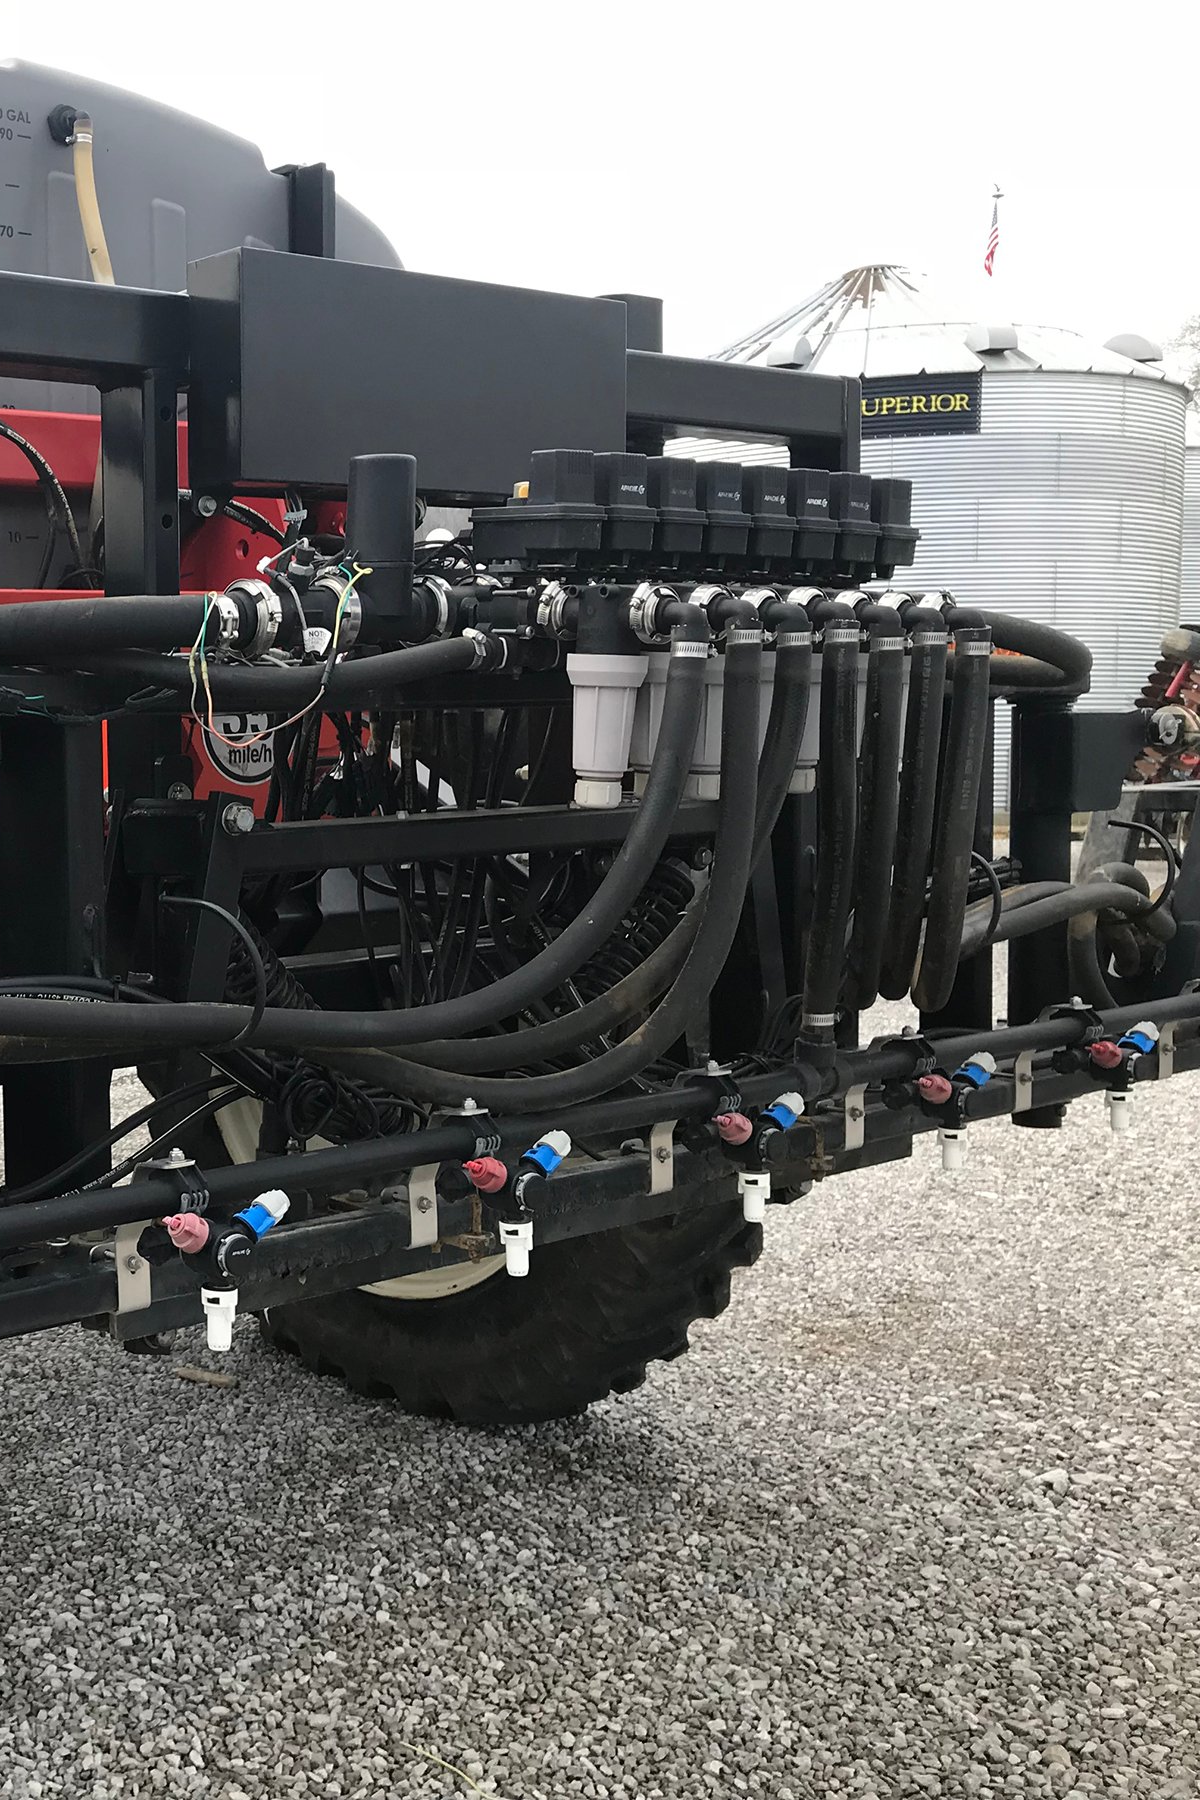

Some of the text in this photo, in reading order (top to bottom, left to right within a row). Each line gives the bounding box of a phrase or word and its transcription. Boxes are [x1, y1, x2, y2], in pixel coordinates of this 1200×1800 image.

[6, 109, 31, 124] GAL
[0, 128, 13, 140] 90
[0, 225, 13, 238] 70
[861, 393, 971, 416] UPERIOR
[8, 531, 21, 543] 10
[228, 744, 272, 763] mile/h
